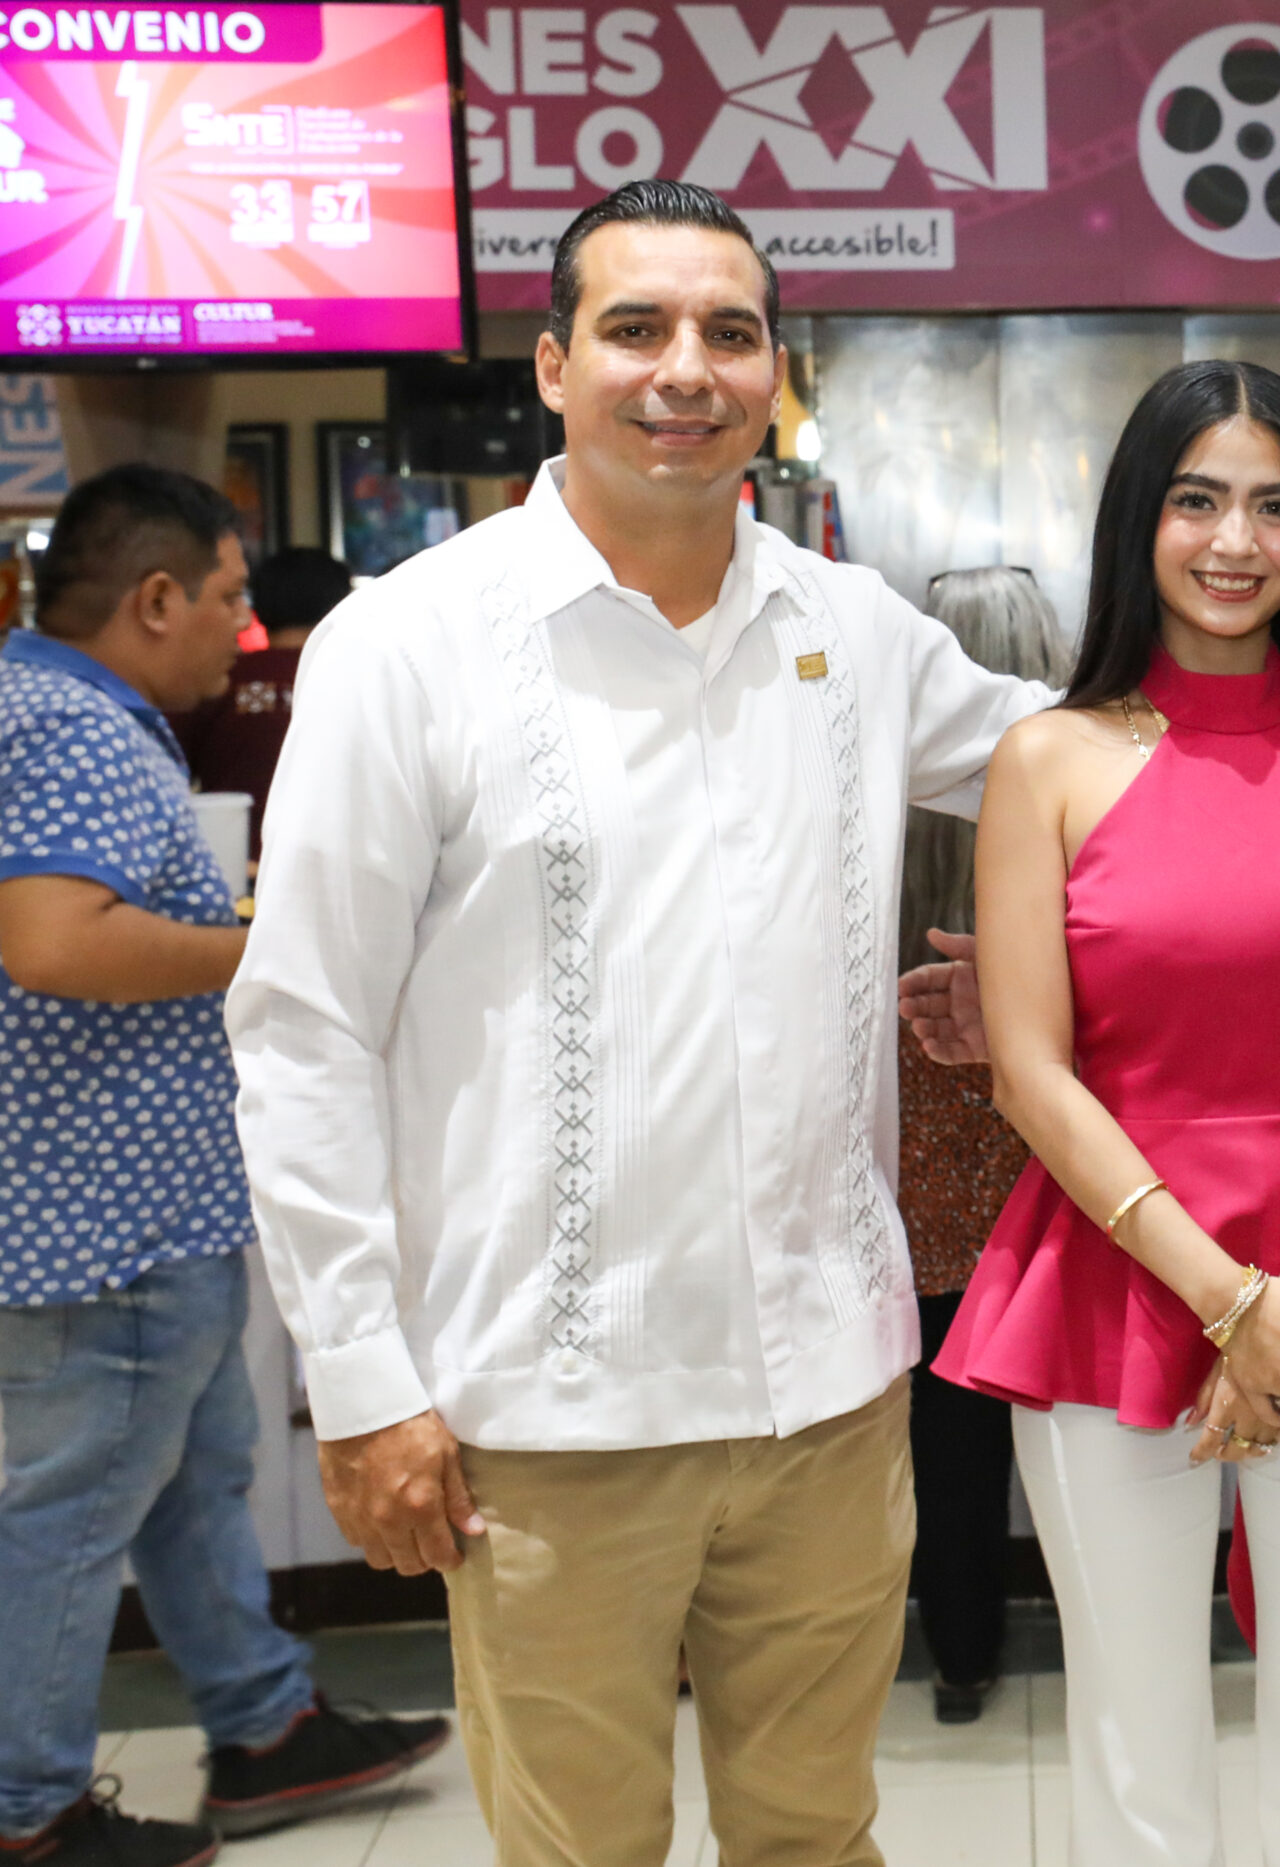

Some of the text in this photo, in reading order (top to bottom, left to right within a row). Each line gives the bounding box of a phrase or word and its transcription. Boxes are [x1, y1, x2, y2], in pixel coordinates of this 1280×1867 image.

[0, 8, 265, 53] ONVENIO
[675, 5, 1048, 190] XXI
[311, 183, 364, 224] 57
[766, 218, 938, 257] accesible!
